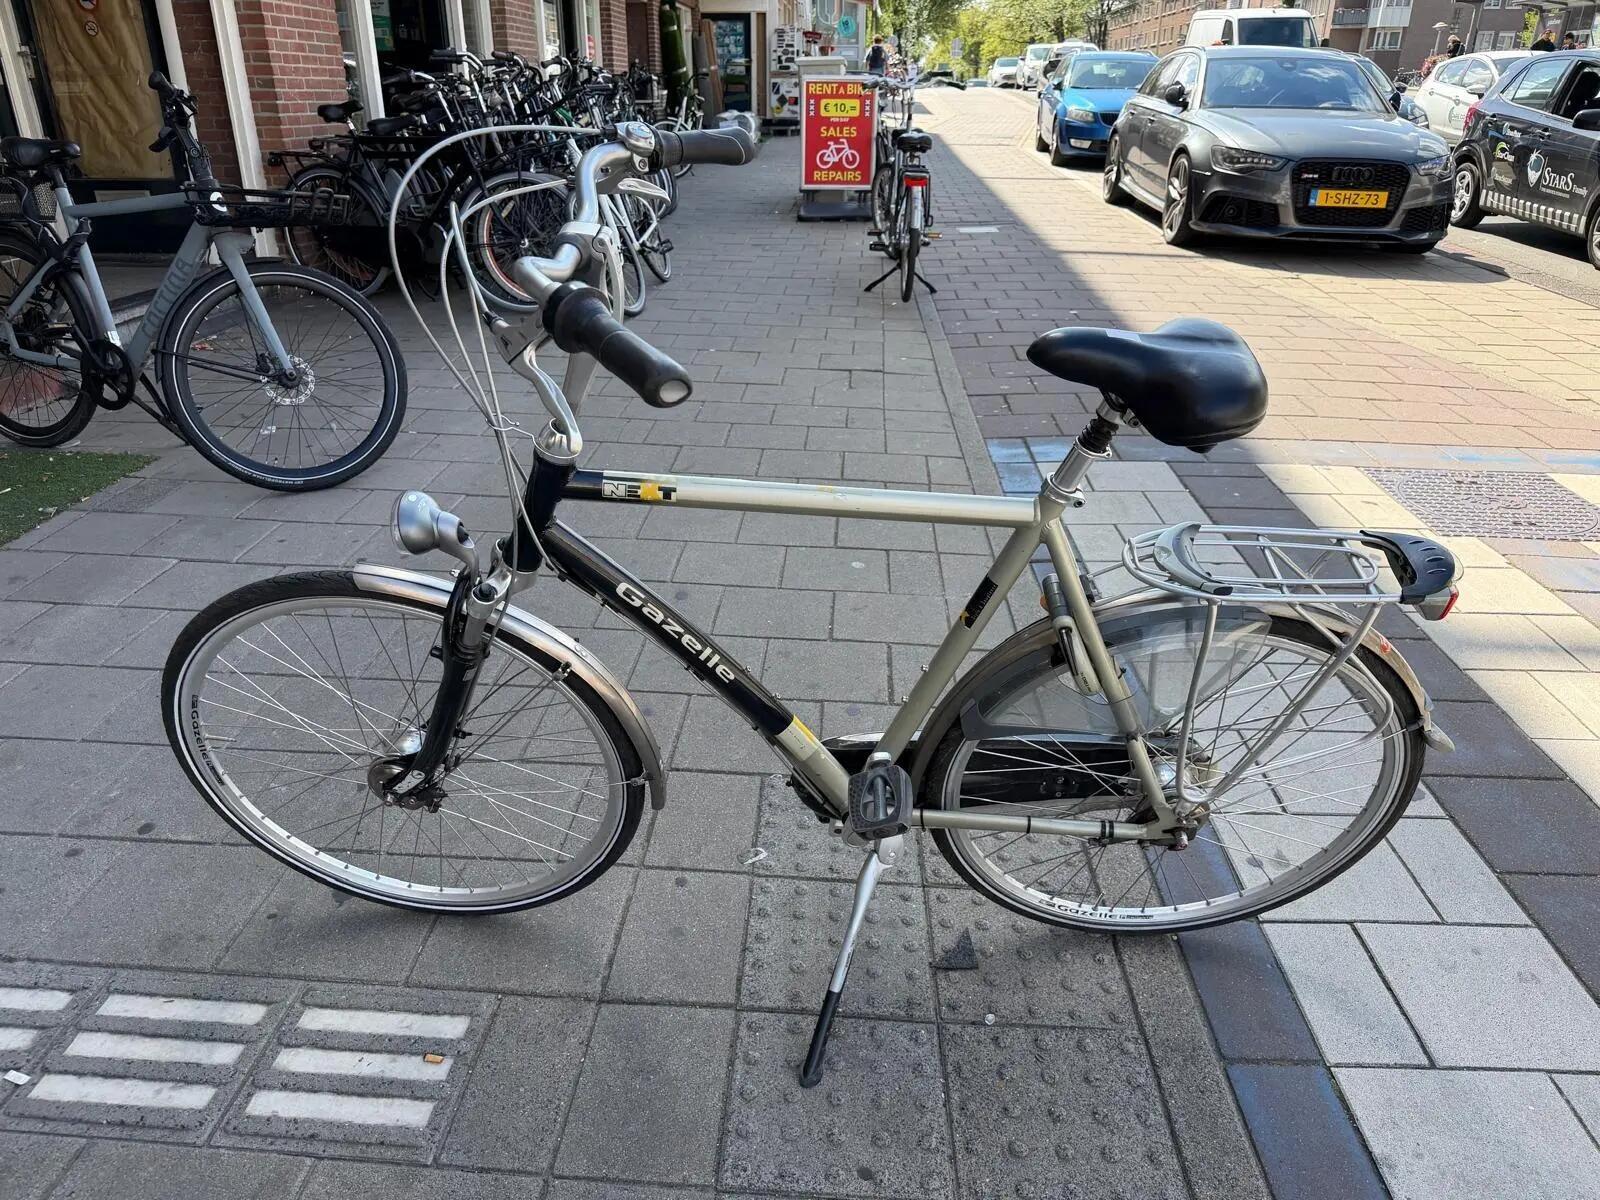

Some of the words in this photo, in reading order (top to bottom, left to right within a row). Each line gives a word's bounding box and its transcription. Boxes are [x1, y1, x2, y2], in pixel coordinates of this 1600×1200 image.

[809, 83, 838, 95] RENT
[839, 86, 845, 95] A
[823, 103, 830, 113] €
[820, 126, 857, 138] SALES
[813, 171, 861, 181] REPAIRS
[1324, 192, 1379, 205] 1-SHZ-73
[616, 582, 735, 684] Gazelle
[191, 710, 209, 760] Gazelle
[1057, 904, 1118, 919] Gazelle
